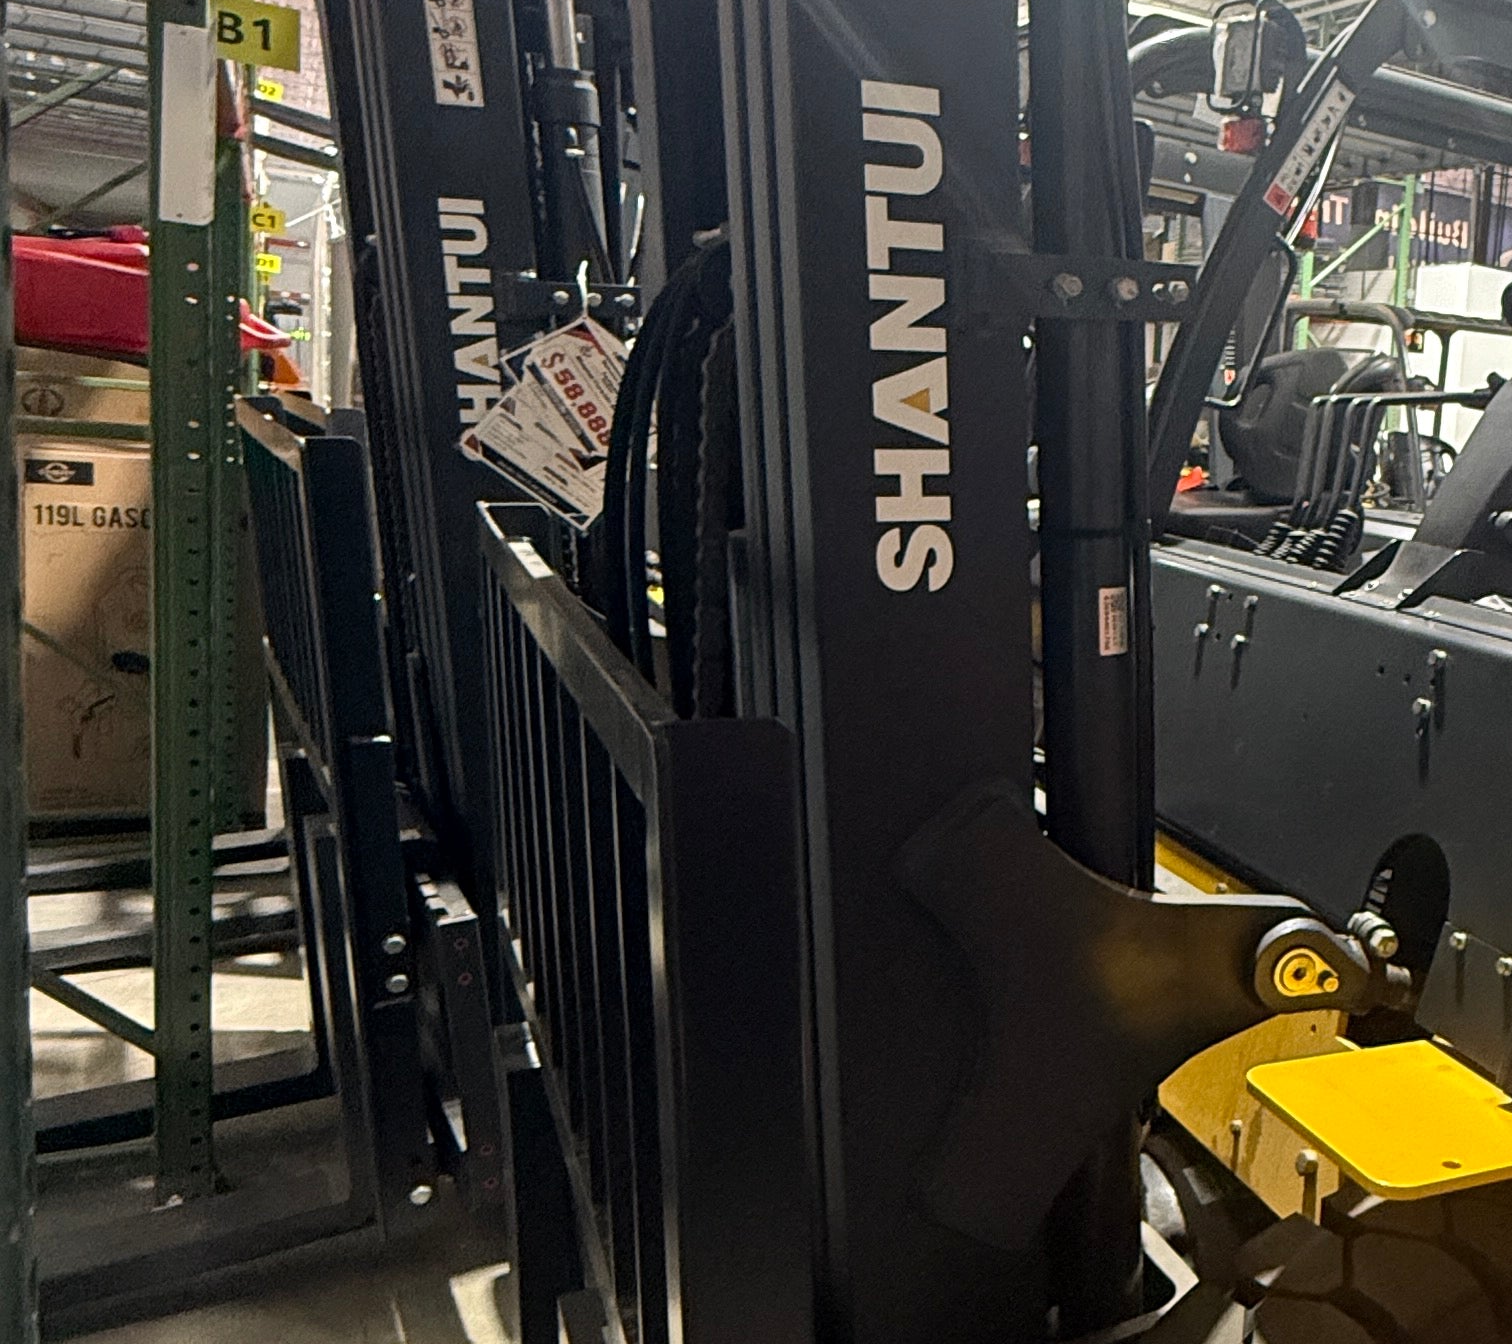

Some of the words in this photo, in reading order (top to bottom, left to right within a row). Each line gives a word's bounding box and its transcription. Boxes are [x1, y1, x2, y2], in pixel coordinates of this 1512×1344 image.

[217, 10, 271, 52] B1
[252, 212, 276, 229] C1
[438, 197, 501, 424] HANTUI
[860, 78, 954, 593] SHANTUI
[34, 505, 86, 527] 119L
